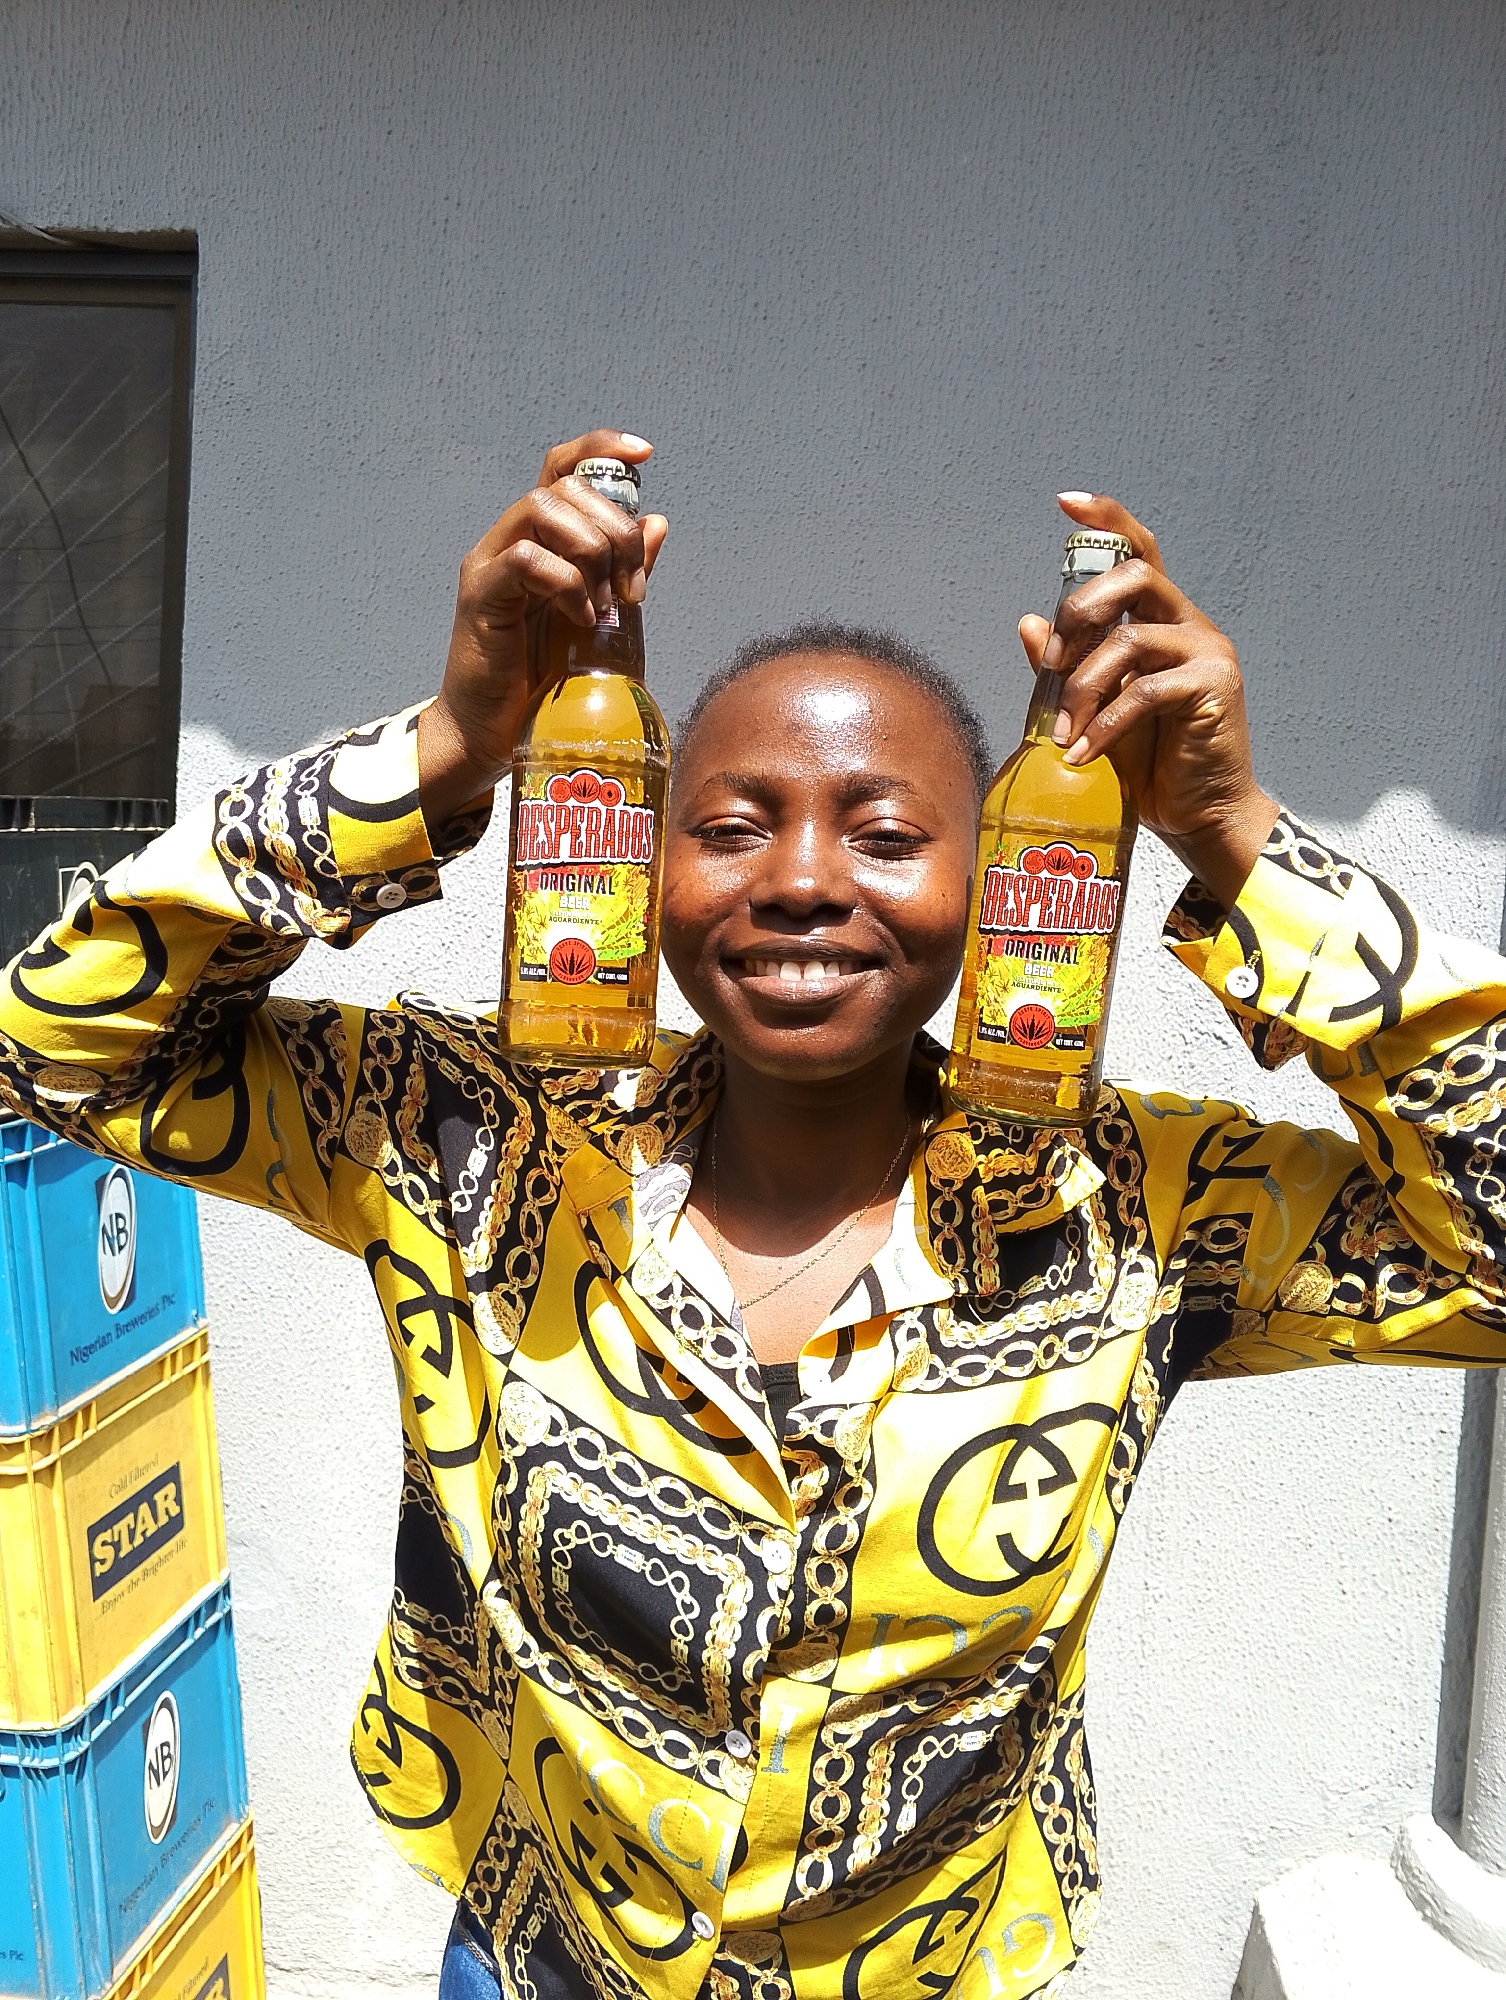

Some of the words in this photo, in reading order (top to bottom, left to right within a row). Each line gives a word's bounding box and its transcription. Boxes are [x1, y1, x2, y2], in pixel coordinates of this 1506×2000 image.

[517, 803, 654, 861] DESPERADOS
[539, 872, 616, 896] ORIGINAL
[558, 895, 590, 910] BEER
[981, 869, 1121, 931] DESPERADOS
[1004, 938, 1080, 965] ORIGINAL
[1023, 962, 1055, 978] BEER
[101, 1211, 128, 1257] NB
[69, 1332, 113, 1366] Nigerian
[115, 1303, 160, 1340] Breweries
[161, 1293, 176, 1311] Plc
[109, 1474, 128, 1498] Cold
[129, 1452, 159, 1485] Filtered
[92, 1480, 181, 1578] STAR
[148, 1740, 174, 1790] NB
